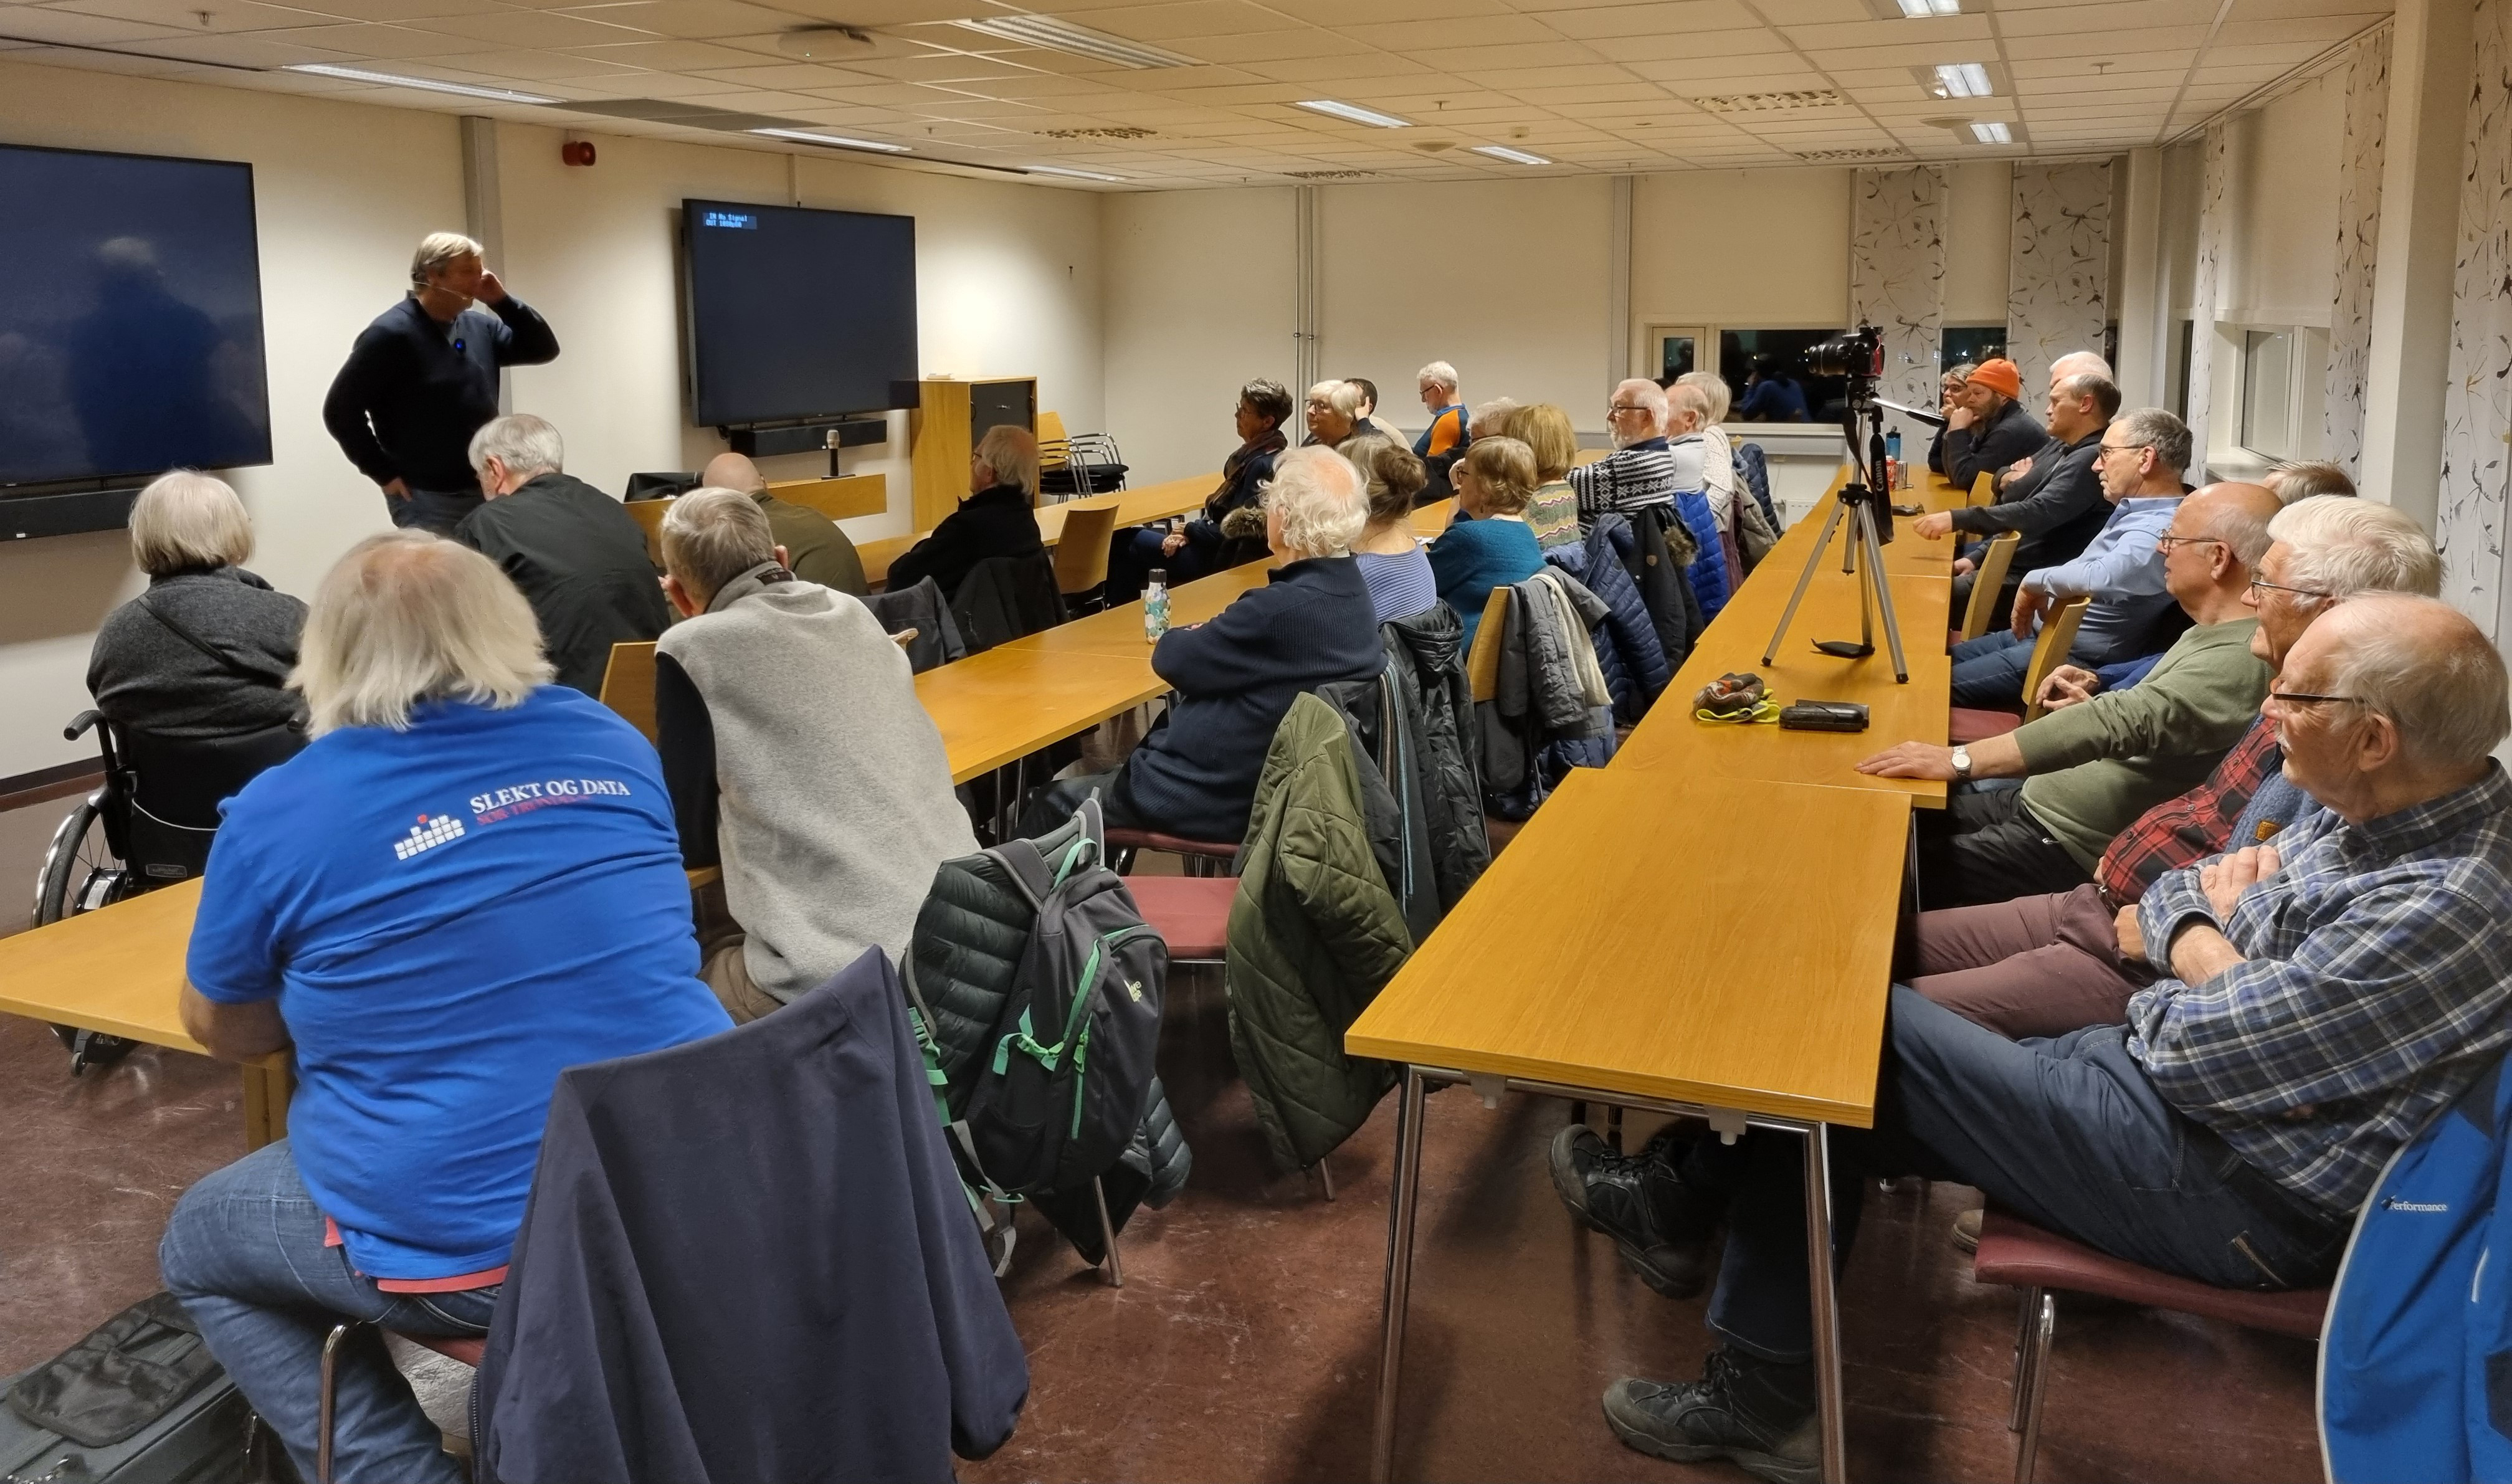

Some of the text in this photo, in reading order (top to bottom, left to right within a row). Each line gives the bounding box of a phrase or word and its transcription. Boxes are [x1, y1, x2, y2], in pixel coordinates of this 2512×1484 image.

[728, 214, 748, 222] Signal
[1875, 460, 1884, 492] Canon
[470, 782, 542, 814] SLEKT
[545, 779, 578, 796] OG
[579, 779, 631, 796] DATA
